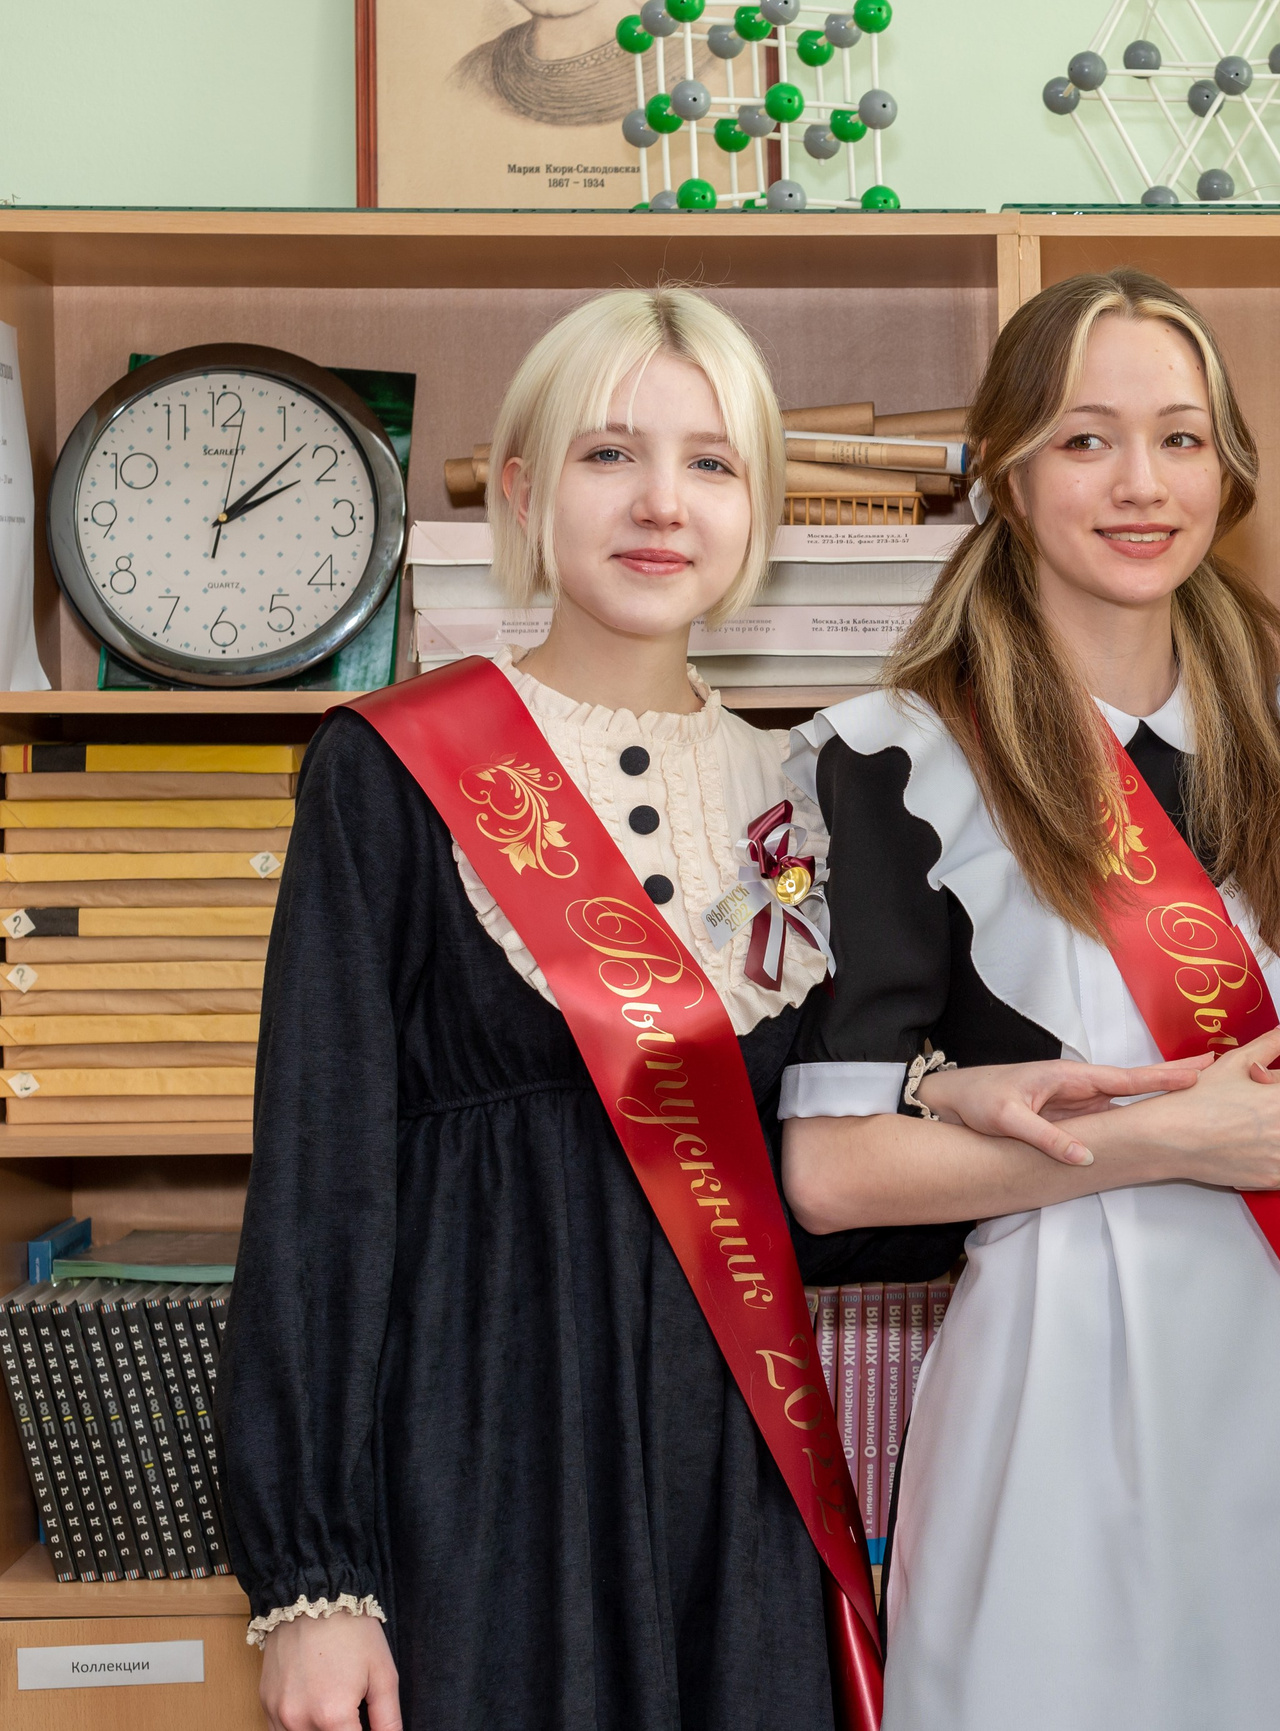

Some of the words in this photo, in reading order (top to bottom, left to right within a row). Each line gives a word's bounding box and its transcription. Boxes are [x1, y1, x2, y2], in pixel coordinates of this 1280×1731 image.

[507, 163, 541, 176] Мария
[548, 178, 570, 188] 1867
[583, 178, 605, 188] 1934
[162, 404, 187, 441] 11
[207, 392, 243, 428] 12
[277, 406, 286, 442] 1
[111, 452, 159, 490] 10
[202, 448, 246, 457] SCARLETT
[312, 445, 338, 482] 2
[91, 500, 118, 539] 9
[331, 499, 356, 537] 3
[110, 556, 137, 595] 8
[207, 581, 241, 590] QUARTZ
[307, 553, 337, 592] 4
[158, 595, 180, 634] 7
[210, 609, 238, 647] 6
[267, 594, 294, 633] 5
[862, 625, 879, 633] факс
[705, 883, 751, 928] ВЫПУСК
[725, 903, 753, 932] 2022
[565, 896, 774, 1310] Выпускник
[19, 1326, 45, 1399] химия
[40, 1326, 66, 1399] химия
[88, 1326, 114, 1399] химия
[130, 1324, 156, 1397] химия
[154, 1322, 179, 1394] химия
[175, 1322, 201, 1395] химия
[822, 1308, 835, 1367] ХИМИЯ
[844, 1308, 857, 1366] ХИМИЯ
[865, 1306, 878, 1365] ХИМИЯ
[888, 1305, 901, 1364] ХИМИЯ
[910, 1304, 923, 1363] ХИМИЯ
[0, 1328, 24, 1401] химия
[61, 1328, 88, 1400] химия
[111, 1326, 148, 1445] задачник
[151, 1484, 177, 1557] химия
[864, 1368, 877, 1458] ОРГАНИЧЕСКАЯ
[886, 1367, 900, 1457] ОРГАНИЧЕСКАЯ
[27, 1440, 64, 1559] задачник
[48, 1439, 86, 1558] задачник
[70, 1439, 107, 1558] задачник
[91, 1438, 130, 1557] задачник
[117, 1437, 154, 1556] задачник
[159, 1436, 196, 1554] задачник
[183, 1433, 219, 1550] задачник
[866, 1463, 874, 1515] НИФАНТЬЕВ
[71, 1661, 150, 1675] Коллекции
